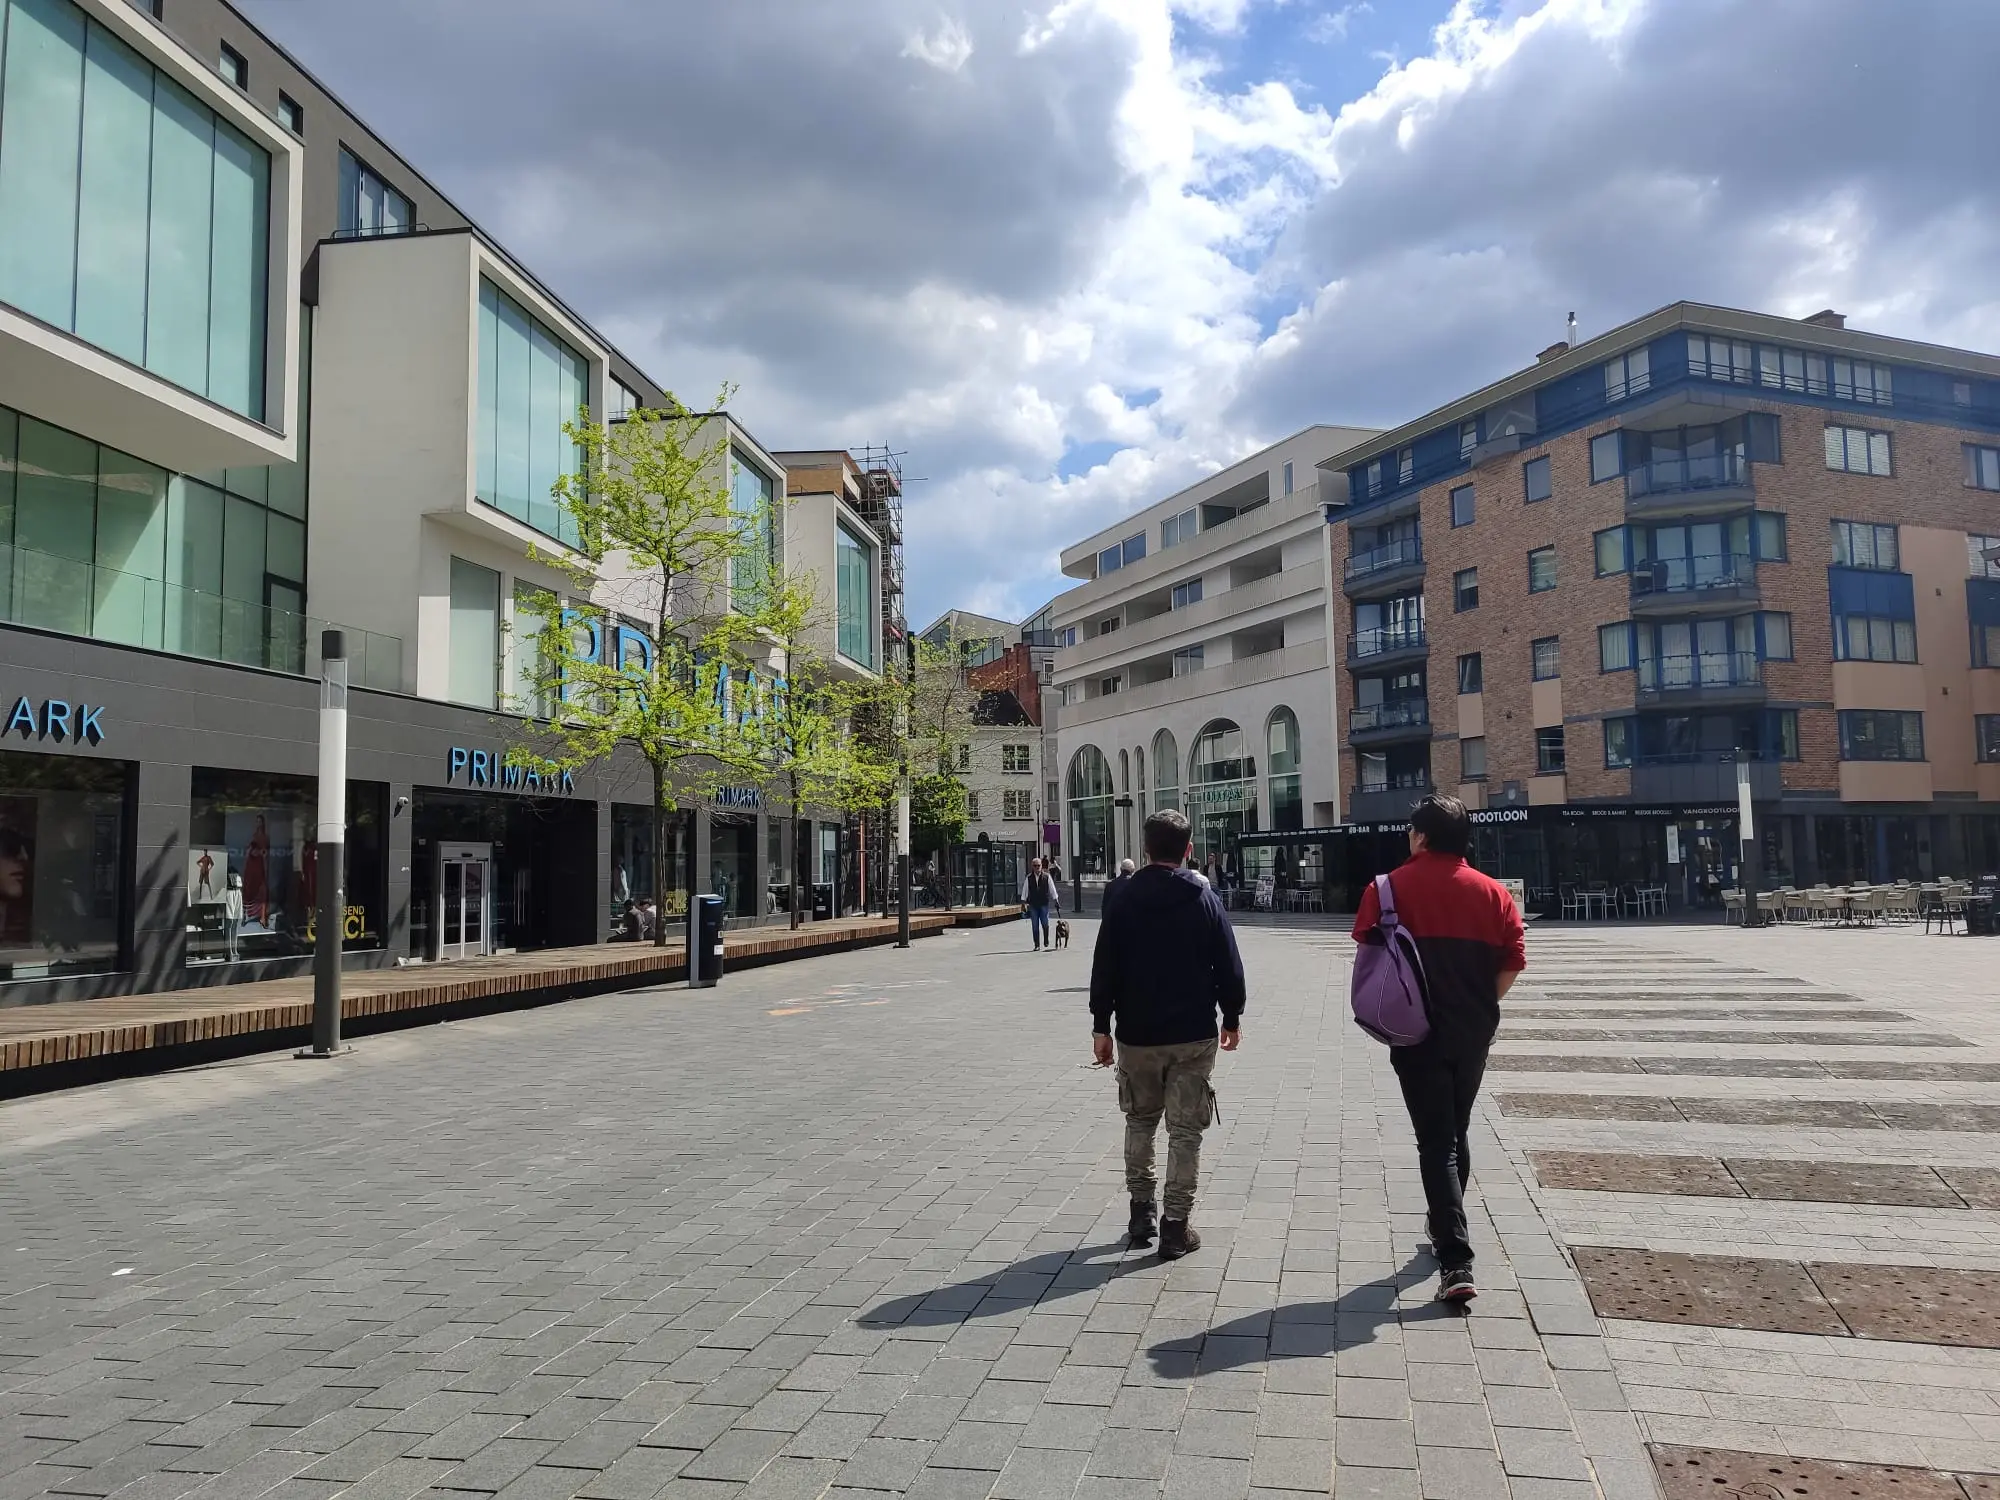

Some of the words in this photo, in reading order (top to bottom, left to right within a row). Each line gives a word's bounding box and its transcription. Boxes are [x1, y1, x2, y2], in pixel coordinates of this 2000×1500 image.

[8, 696, 105, 740] ARK
[710, 784, 761, 808] PRIMARK
[1469, 809, 1528, 823] ROOTLOON
[341, 905, 365, 916] SEND
